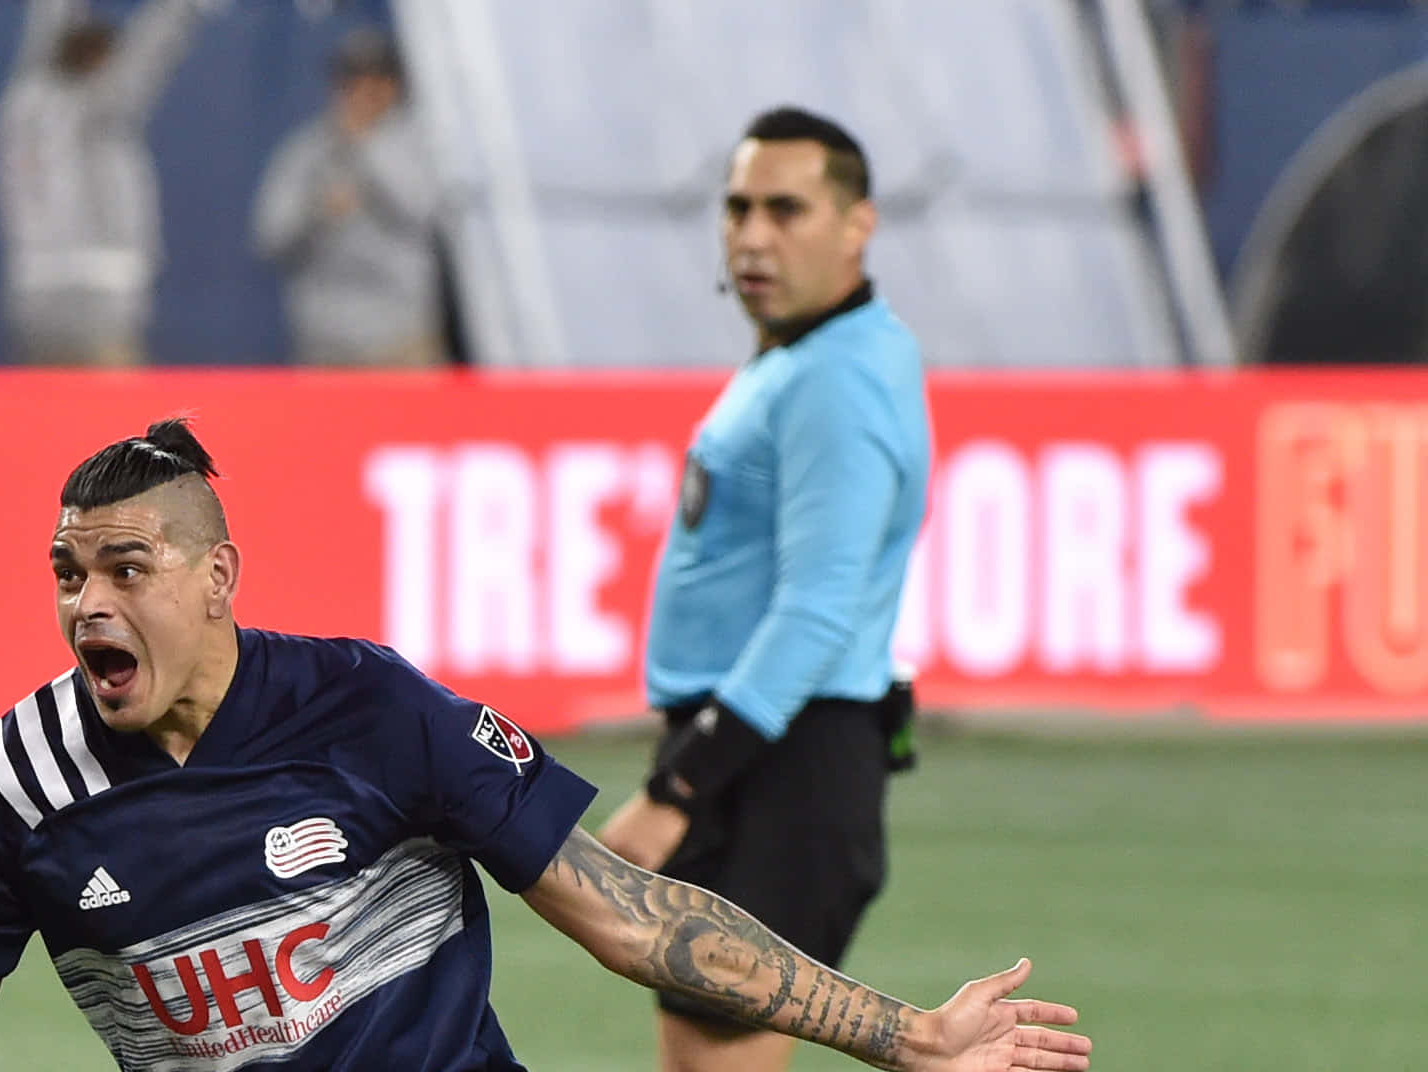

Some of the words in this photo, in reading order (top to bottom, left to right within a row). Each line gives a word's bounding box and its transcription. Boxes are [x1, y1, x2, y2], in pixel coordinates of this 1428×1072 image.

[360, 440, 675, 676] TRE'
[892, 438, 1224, 678] ORE
[79, 890, 131, 910] adidas
[132, 921, 336, 1036] UHC
[173, 991, 342, 1058] UnitedHealthcare
